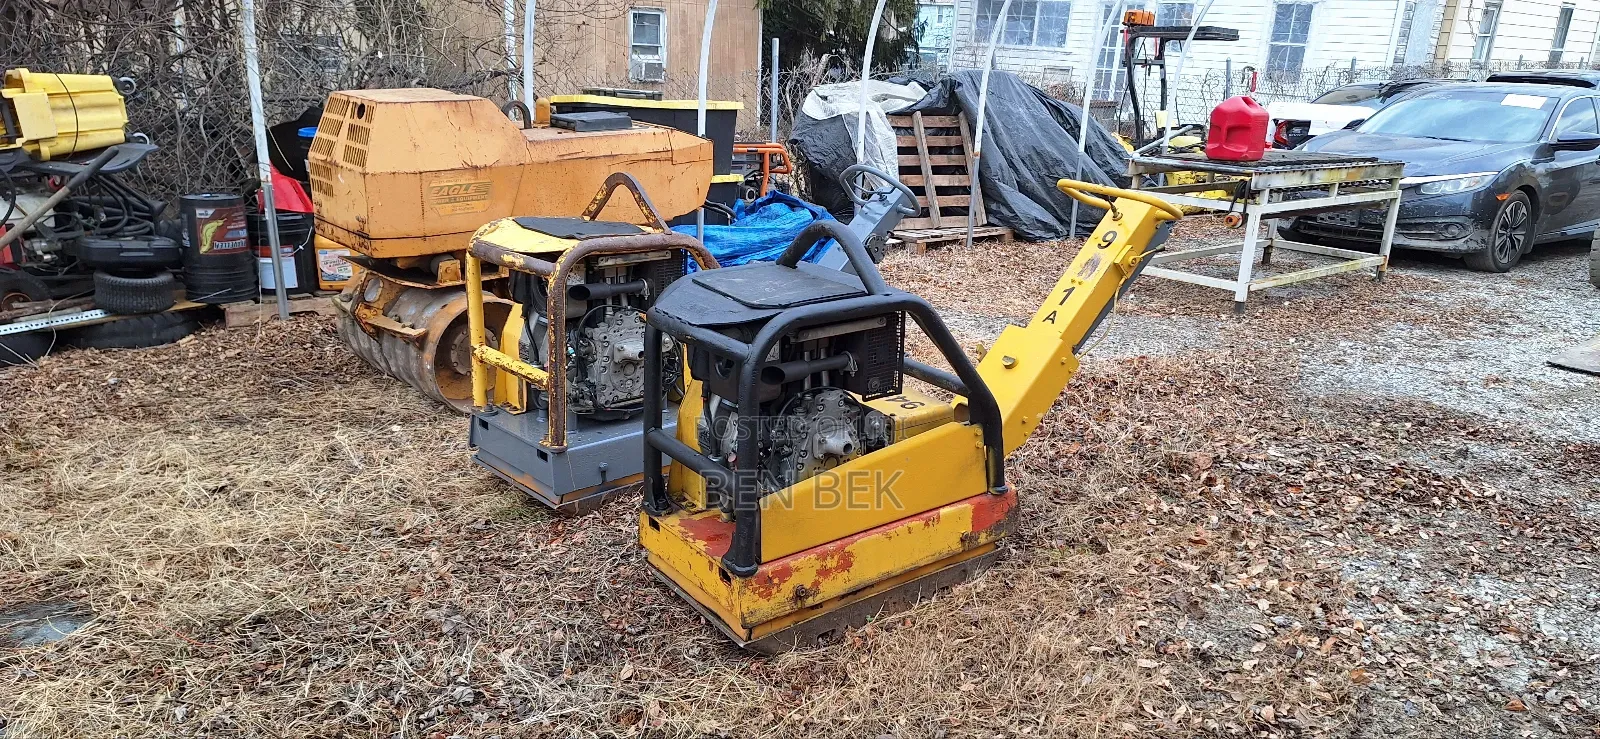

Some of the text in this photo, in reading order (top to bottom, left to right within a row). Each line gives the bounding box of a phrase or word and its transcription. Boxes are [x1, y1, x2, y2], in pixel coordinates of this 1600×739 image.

[431, 183, 479, 197] EAGLE
[456, 194, 488, 202] EQUIPMENT
[1097, 230, 1118, 250] 9
[1058, 286, 1075, 306] 1
[1042, 310, 1058, 325] A
